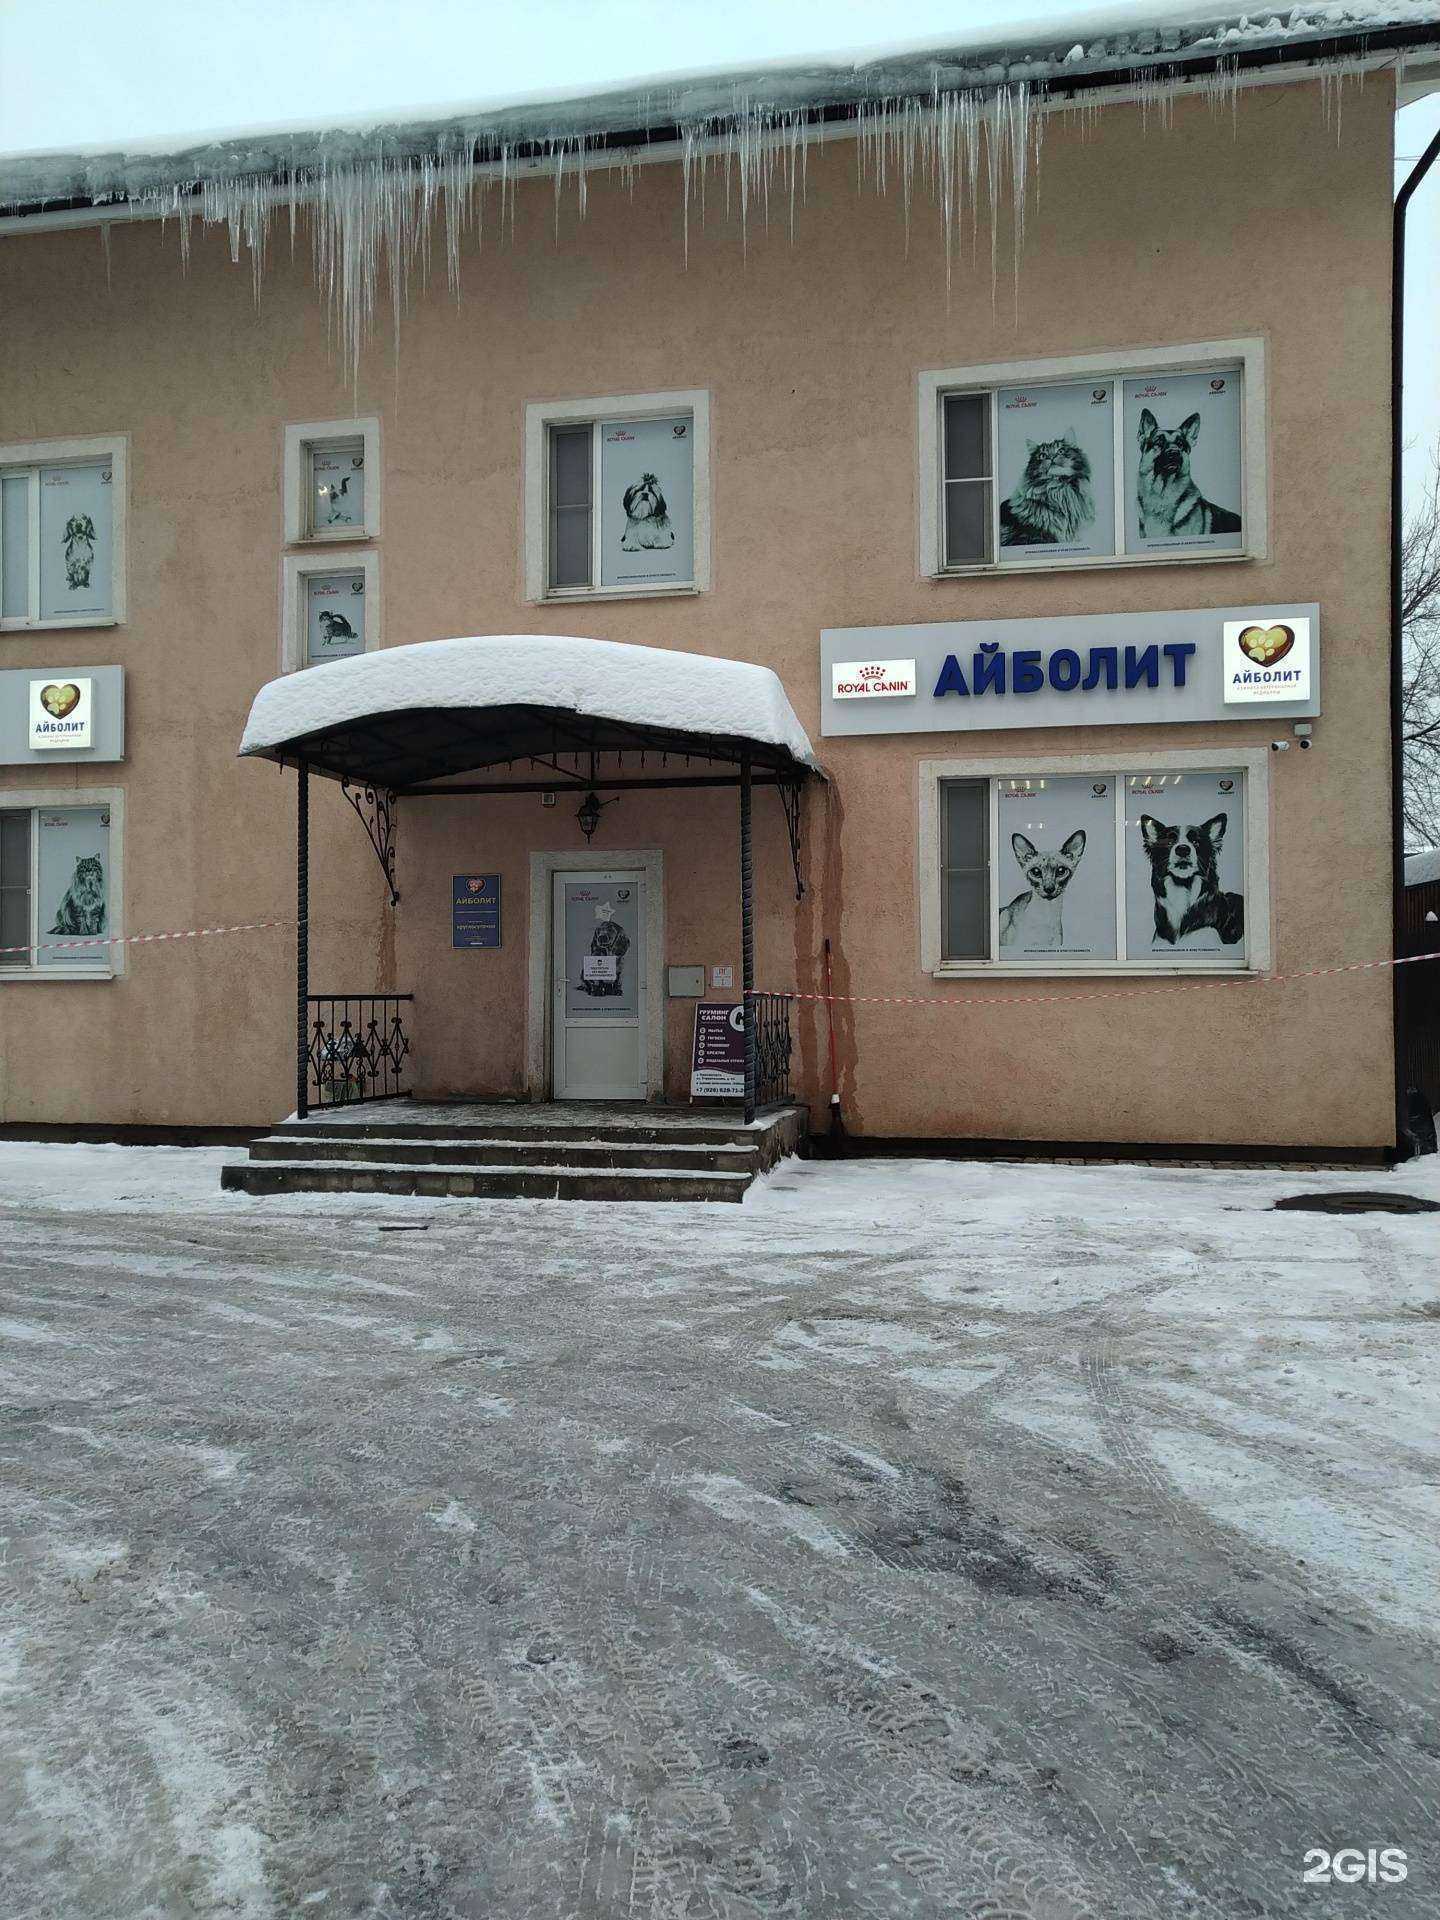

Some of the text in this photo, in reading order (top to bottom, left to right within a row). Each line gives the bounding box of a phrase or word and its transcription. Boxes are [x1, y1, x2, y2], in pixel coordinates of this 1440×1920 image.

[933, 642, 1196, 698] АЙБОЛИТ
[1232, 669, 1302, 684] АЙБОЛИТ
[837, 681, 908, 693] ROYAL CANIN
[35, 721, 85, 733] АЙБОЛИТ
[456, 896, 497, 904] АЙБОЛИТ
